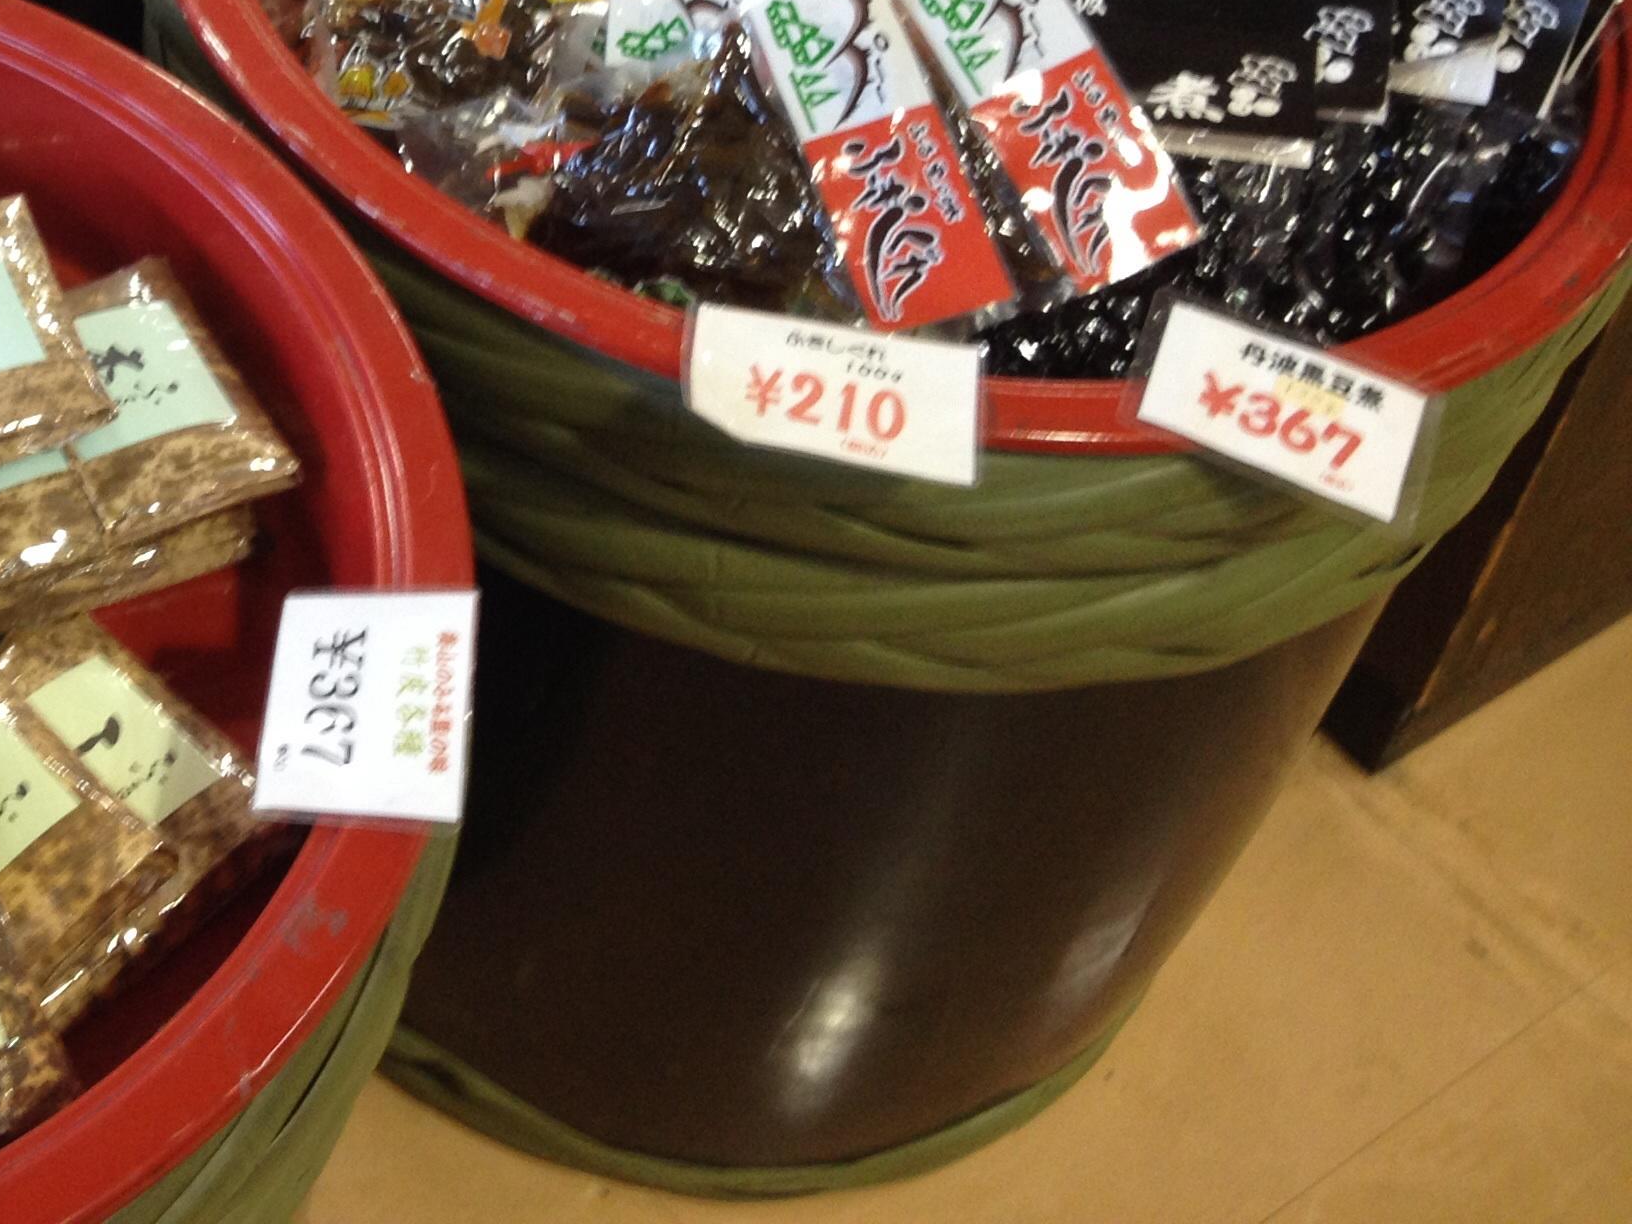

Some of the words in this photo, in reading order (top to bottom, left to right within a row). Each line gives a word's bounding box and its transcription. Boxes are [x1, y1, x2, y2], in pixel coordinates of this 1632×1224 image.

[745, 363, 905, 441] ¥210
[1199, 370, 1363, 470] ¥367
[301, 626, 368, 767] ¥367
